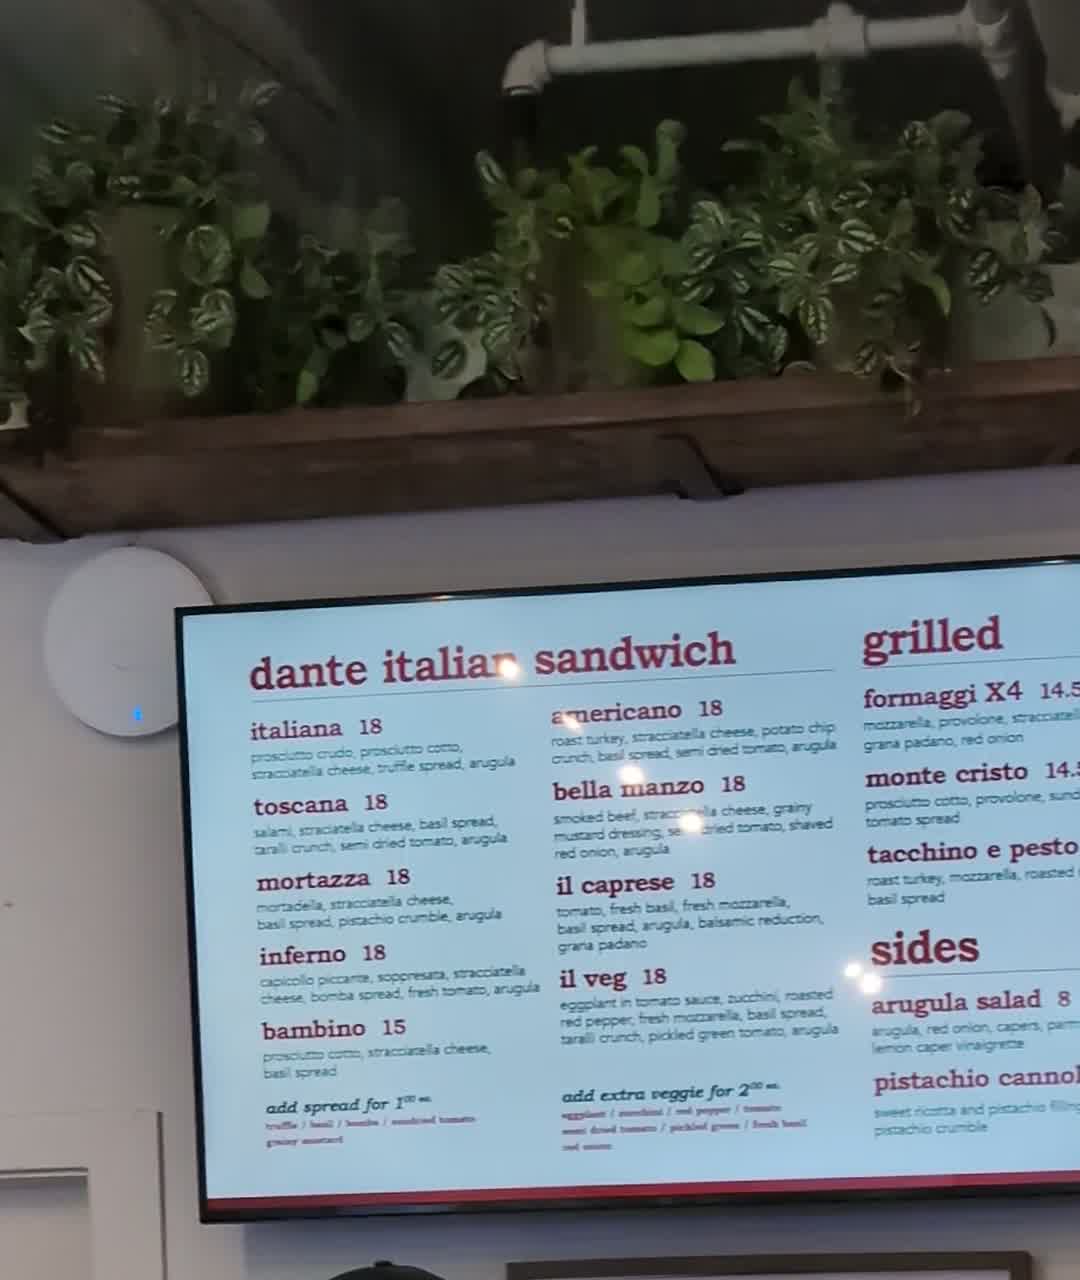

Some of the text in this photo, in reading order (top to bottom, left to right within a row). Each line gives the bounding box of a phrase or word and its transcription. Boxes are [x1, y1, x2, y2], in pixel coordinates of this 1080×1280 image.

[863, 617, 1003, 668] grilled
[251, 657, 367, 689] dante
[535, 632, 736, 674] sandwich
[699, 699, 723, 716] 18
[864, 686, 977, 710] formaggi
[985, 681, 1023, 702] X4
[251, 717, 382, 740] italiana 18
[553, 774, 745, 800] bella manzo 18
[865, 769, 946, 787] monte
[956, 764, 1028, 782] cristo
[254, 792, 388, 815] toscana 18
[867, 843, 977, 863] tacchino
[987, 845, 1001, 857] e
[1010, 839, 1078, 862] pesto
[257, 867, 410, 891] mortazza 18
[557, 871, 715, 898] il caprese 18
[260, 943, 385, 965] inferno 18
[871, 932, 979, 965] sides
[560, 966, 666, 991] il veg 18
[872, 990, 1071, 1018] arugula salad 8
[261, 1017, 406, 1039] bambino 15
[562, 1088, 594, 1102] add
[600, 1088, 645, 1100] extra
[651, 1085, 704, 1103] veggie
[707, 1084, 733, 1102] for
[875, 1070, 989, 1096] pistachio
[266, 1100, 298, 1113] add
[304, 1097, 359, 1117] spread
[363, 1097, 388, 1115] for
